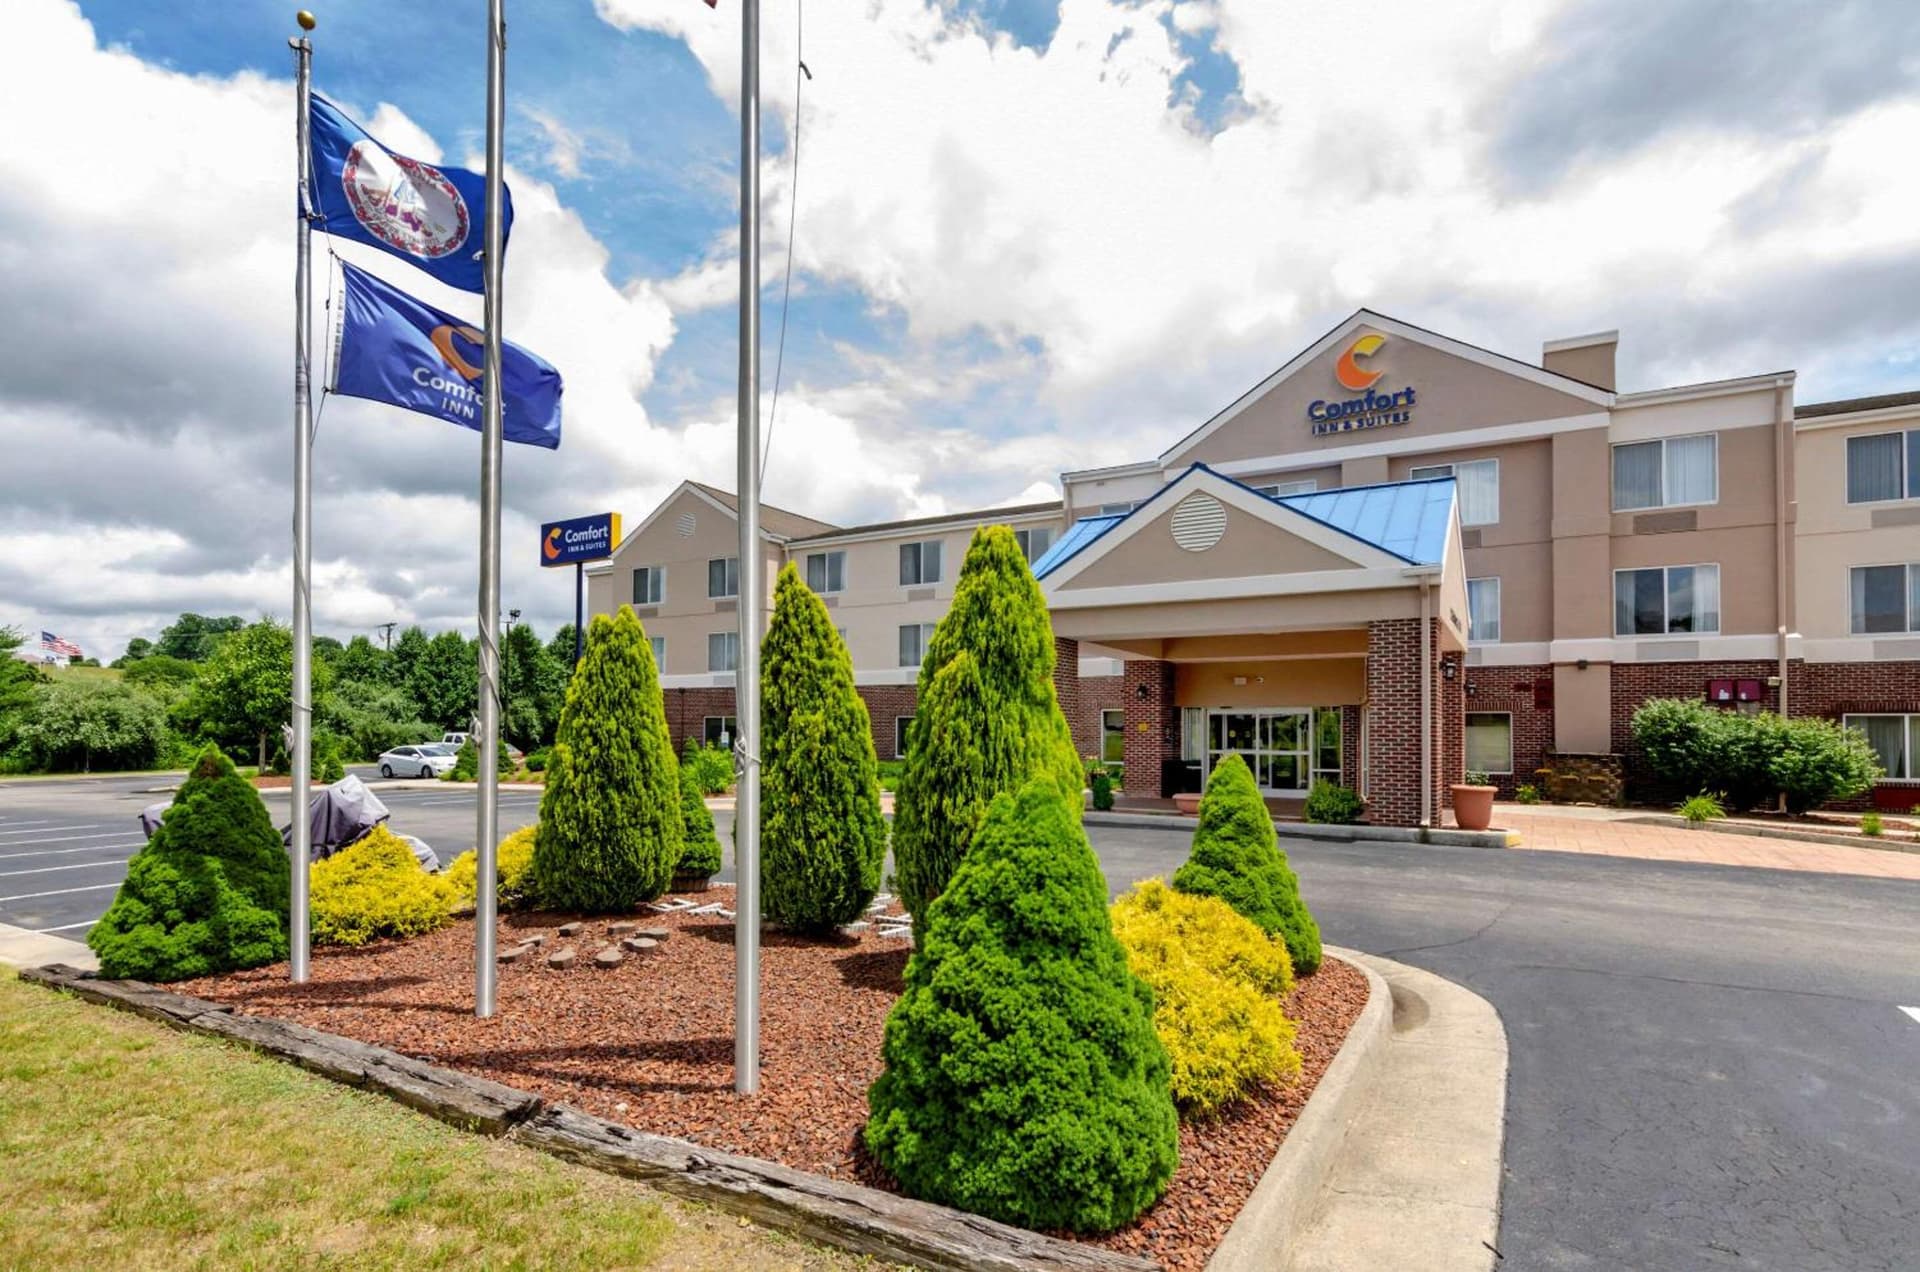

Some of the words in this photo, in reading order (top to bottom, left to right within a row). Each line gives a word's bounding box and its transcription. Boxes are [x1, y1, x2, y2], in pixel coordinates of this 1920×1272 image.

[412, 367, 506, 416] Comfo
[1308, 386, 1416, 421] Comfort
[442, 397, 475, 419] INN
[1312, 421, 1339, 436] INN
[1343, 420, 1353, 431] &
[1356, 411, 1411, 428] SUITES
[565, 524, 608, 543] Comfort
